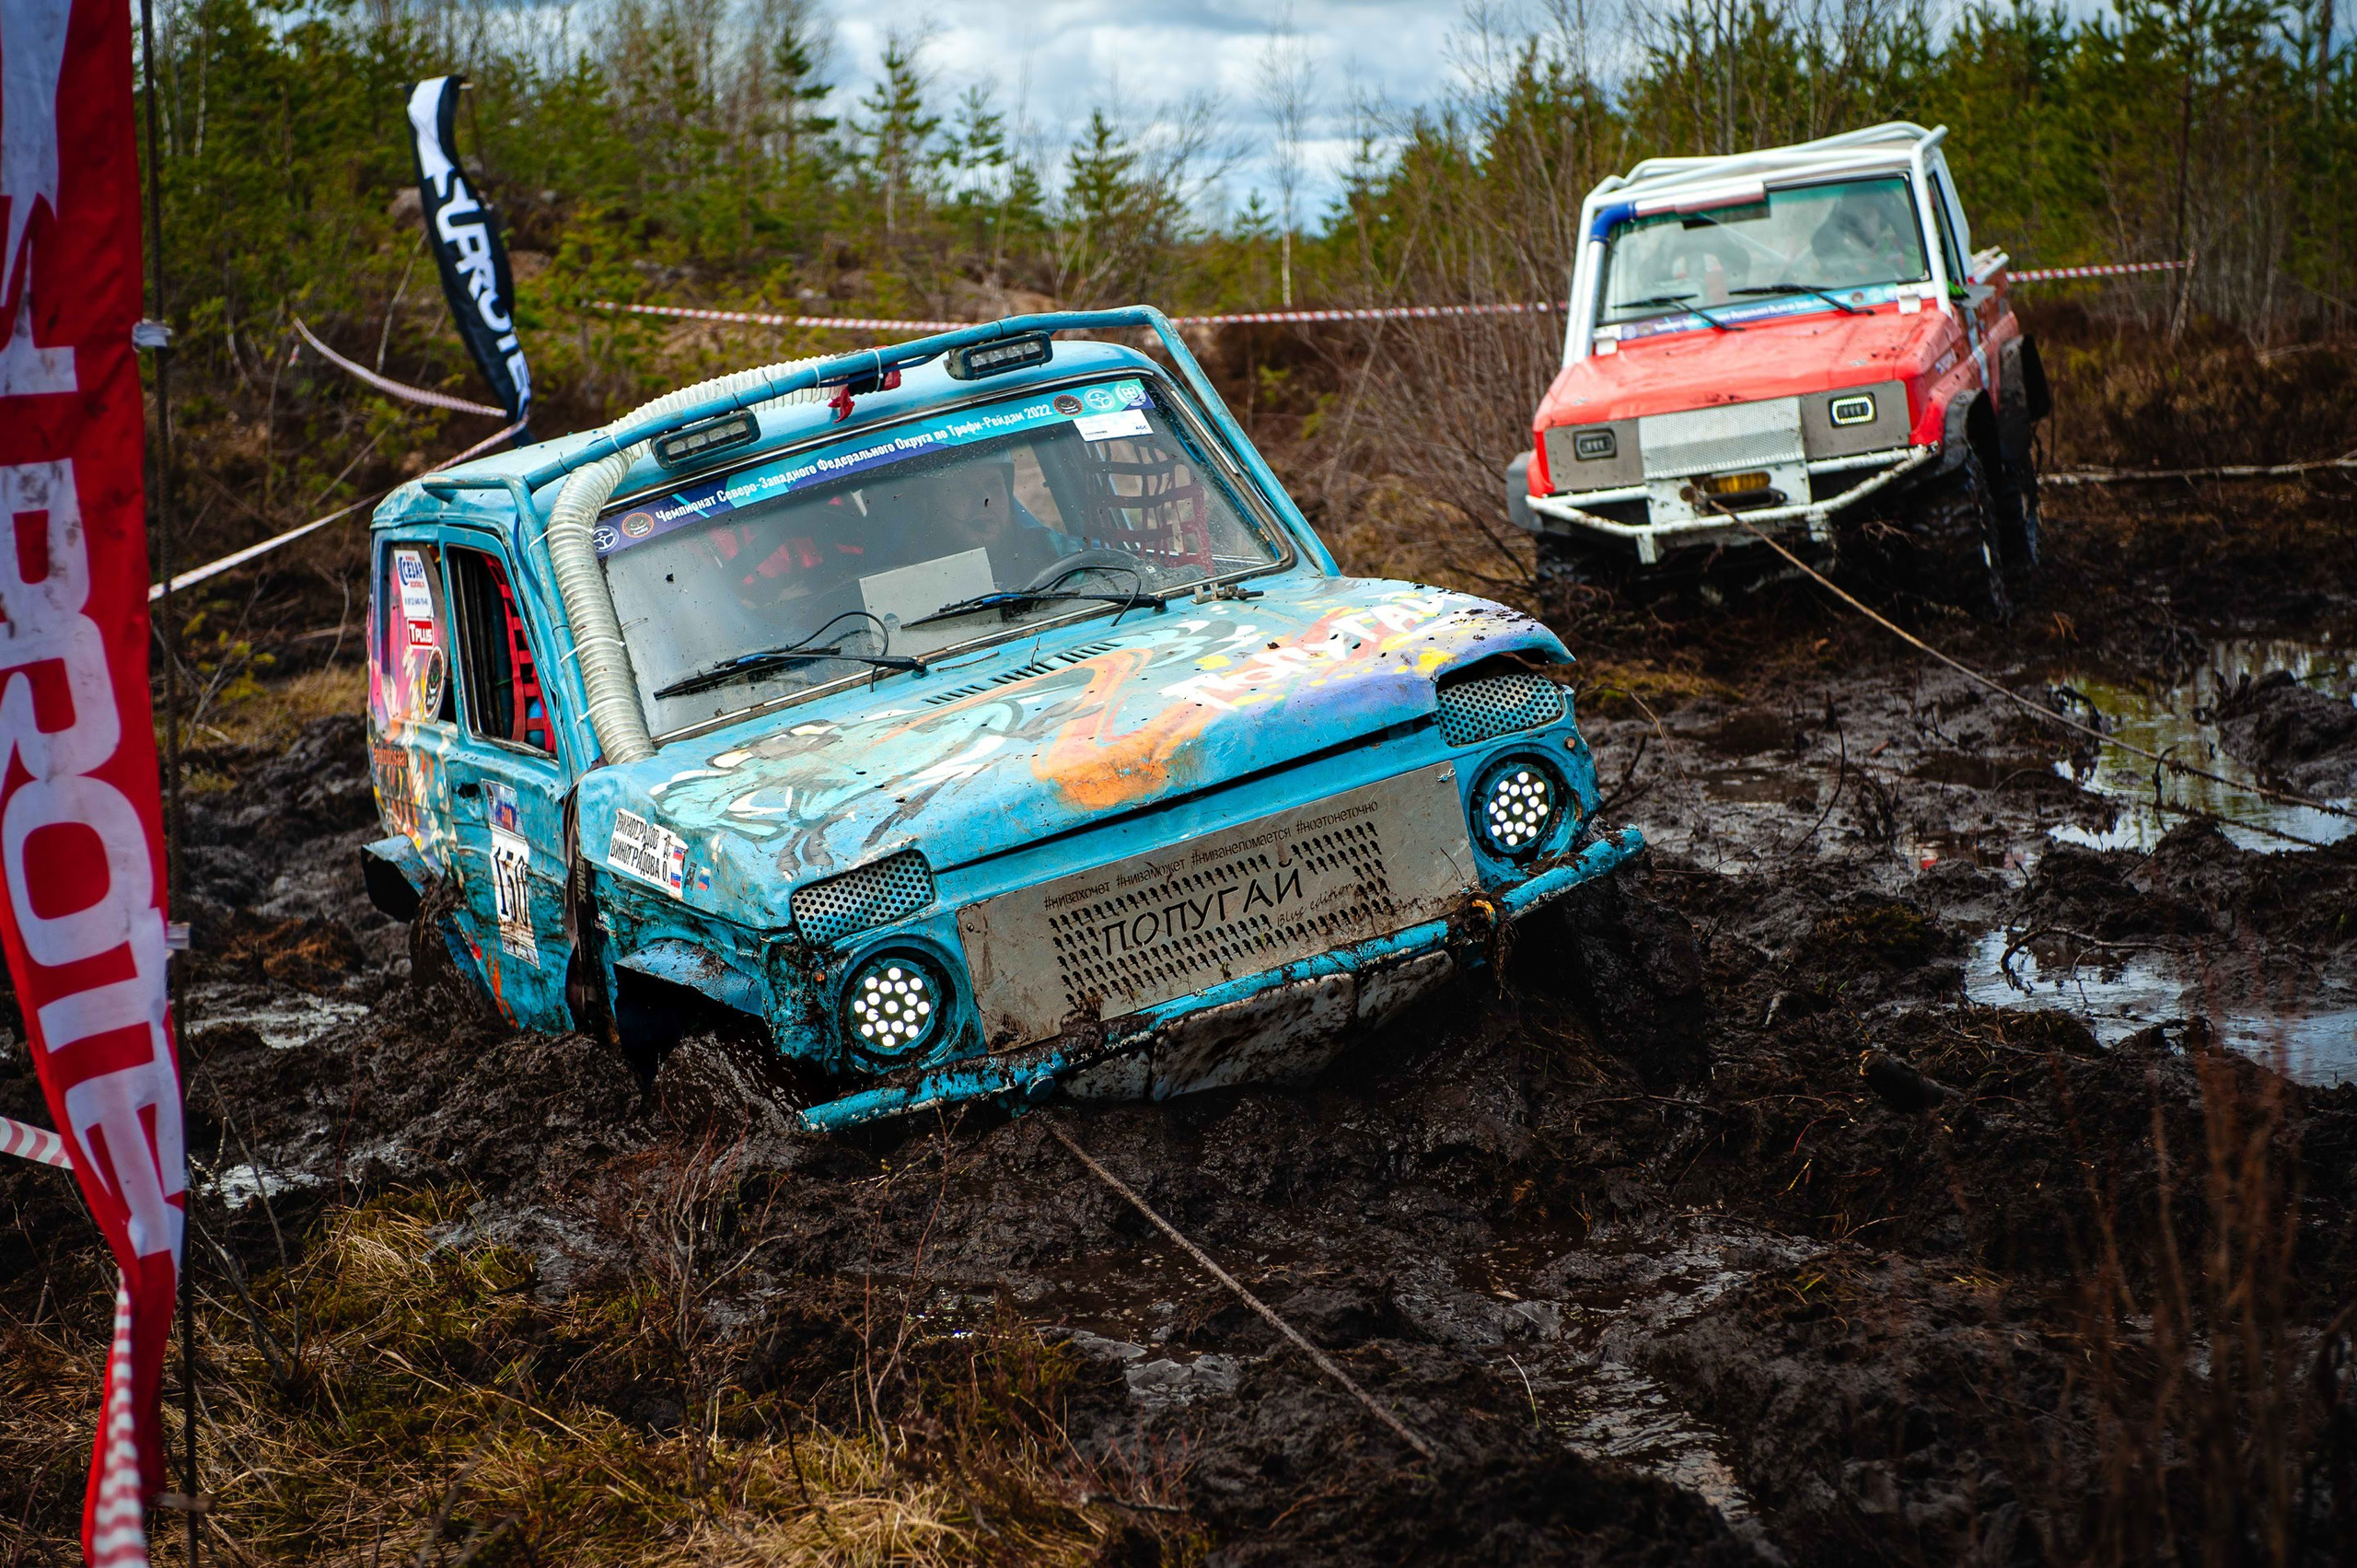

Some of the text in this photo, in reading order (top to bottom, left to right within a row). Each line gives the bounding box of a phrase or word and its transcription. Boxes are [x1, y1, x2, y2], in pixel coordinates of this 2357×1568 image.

[656, 404, 1052, 523] Чемпионат Северо-Западного Федерального Округа по Трофи-Рейдам 2022
[1043, 800, 1379, 911] #нивахочет #ниваможет #ниванеломается #ноэтонеточно
[1102, 857, 1303, 956] ПОПУГАЙ
[1276, 880, 1357, 927] Blue edition
